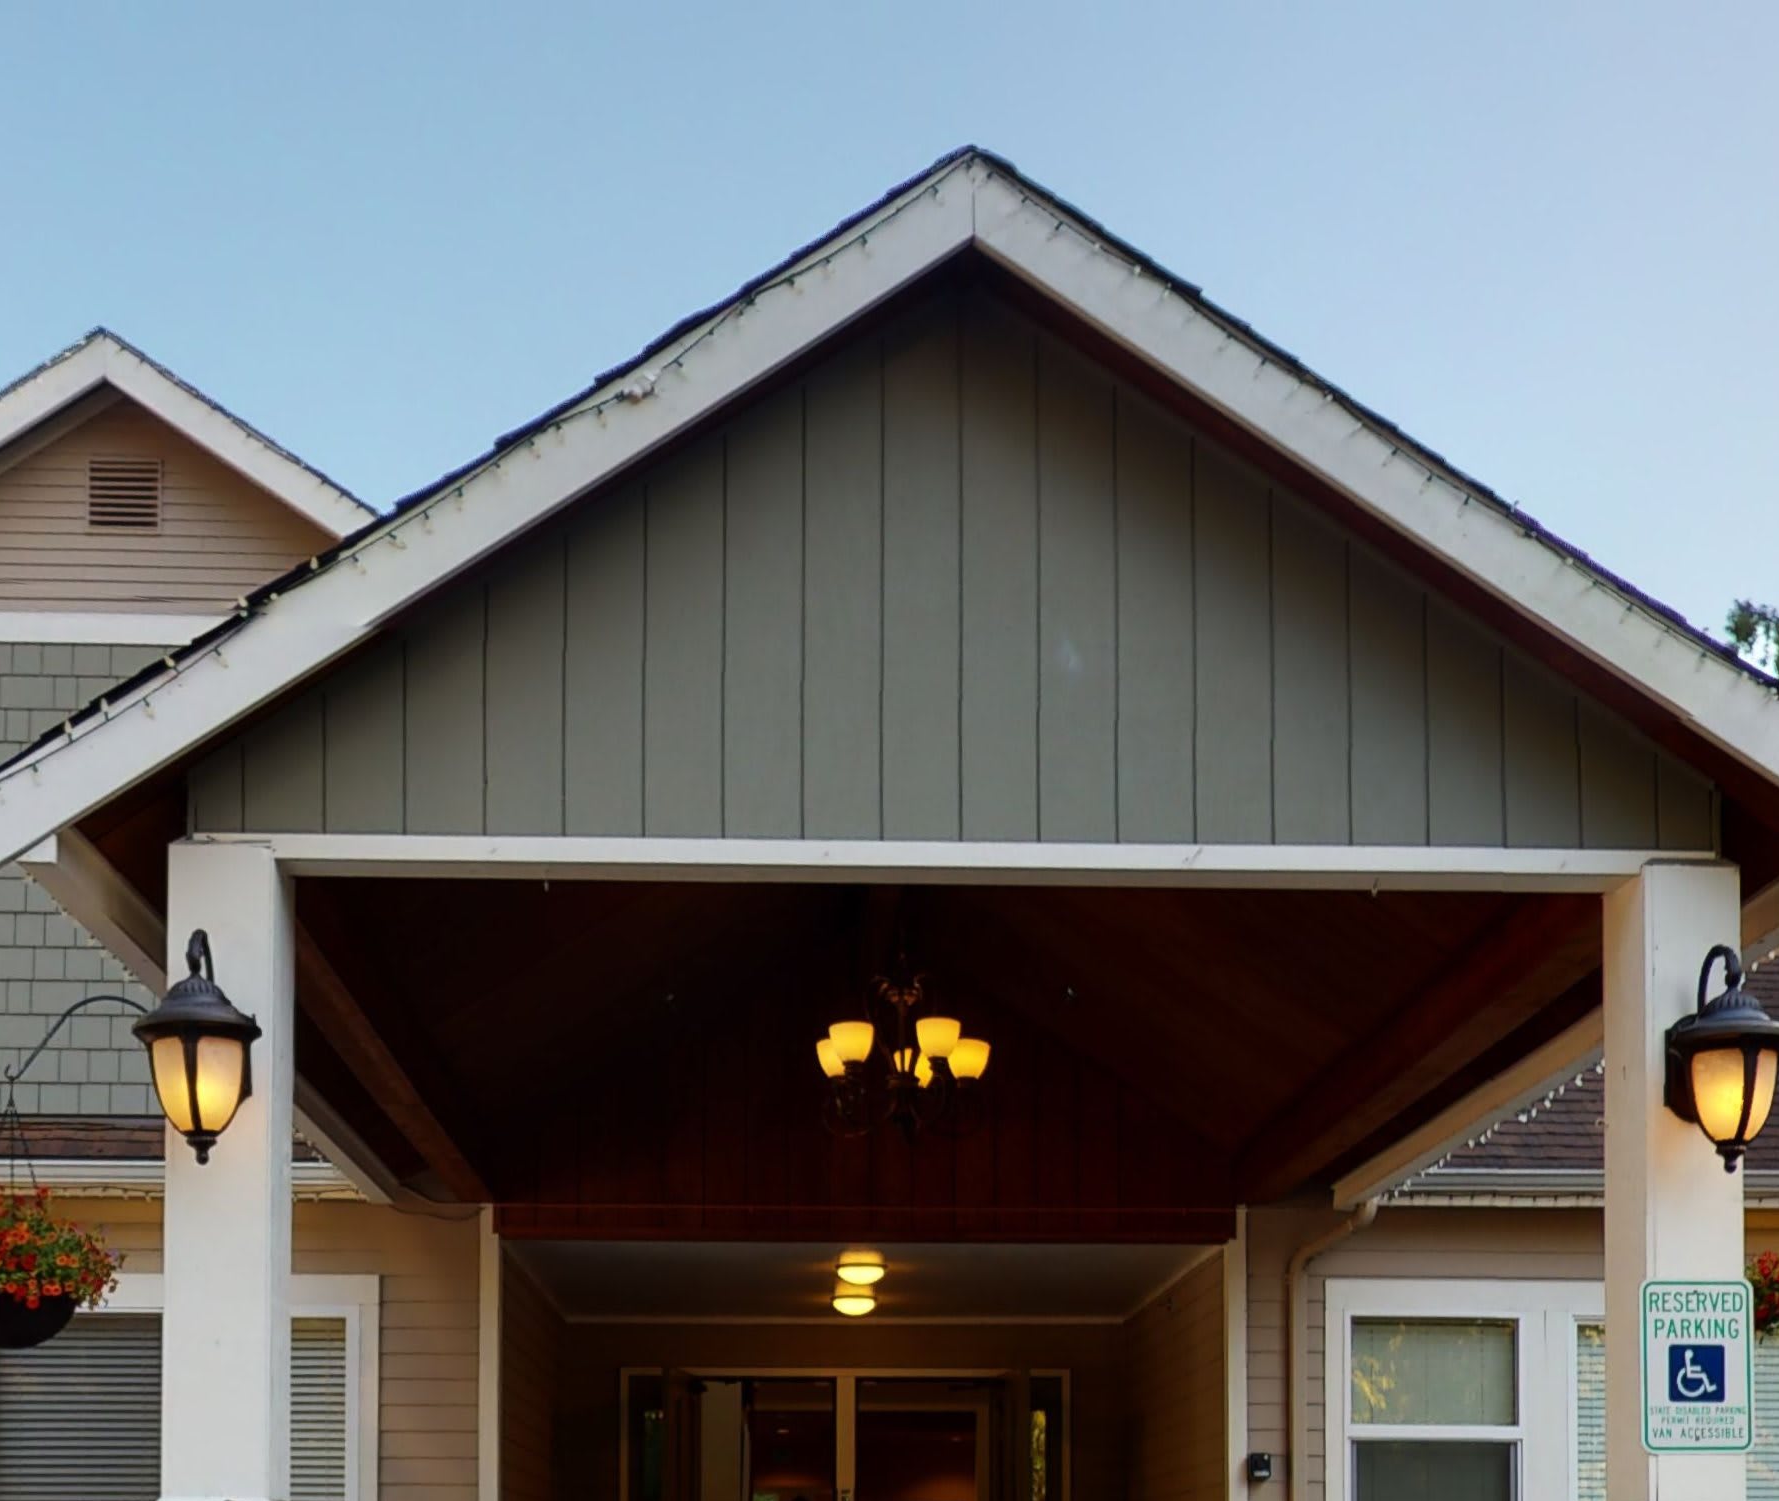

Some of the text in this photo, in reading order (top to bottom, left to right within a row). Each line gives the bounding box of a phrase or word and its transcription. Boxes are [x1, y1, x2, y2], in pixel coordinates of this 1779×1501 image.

[1649, 1291, 1743, 1313] RESERVED
[1654, 1318, 1739, 1339] PARKING
[1650, 1406, 1747, 1415] STATE DISABLED PARKING
[1661, 1416, 1734, 1424] PERMIT REQUIRED
[1652, 1427, 1744, 1439] VAN ACCESSIBLE
